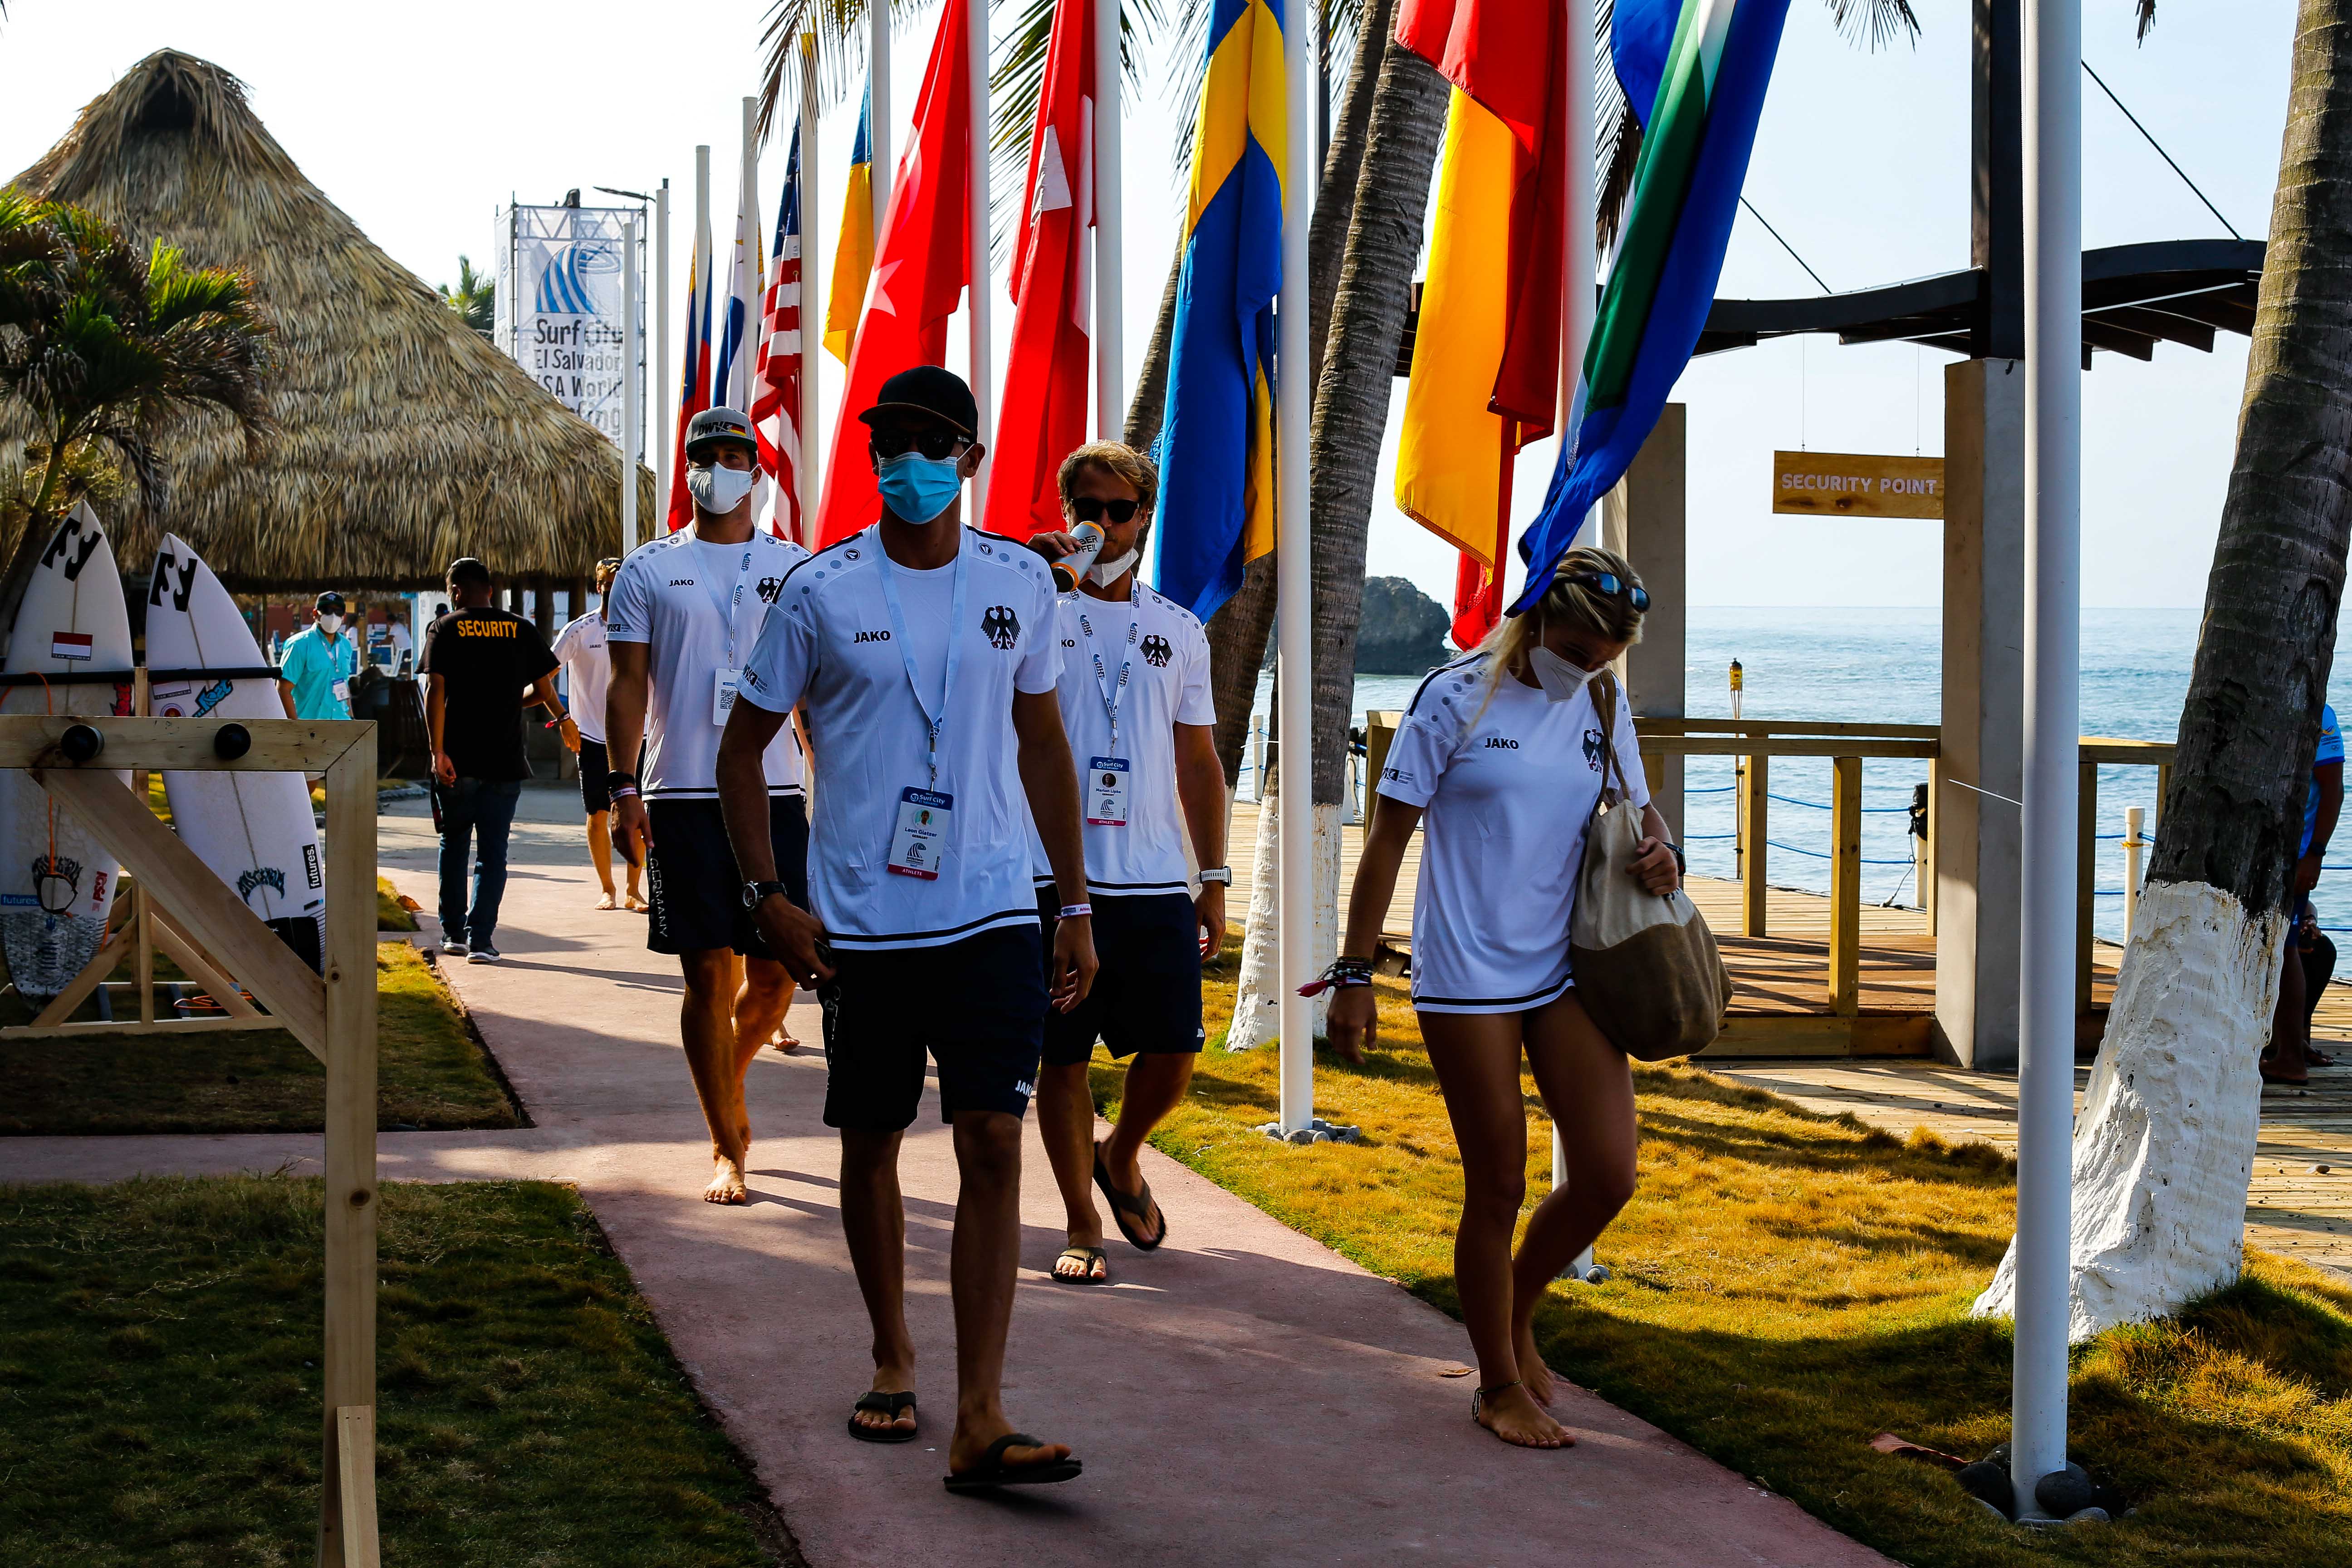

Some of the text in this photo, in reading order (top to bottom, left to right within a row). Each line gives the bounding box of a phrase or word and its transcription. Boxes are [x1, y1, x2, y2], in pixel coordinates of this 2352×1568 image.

[534, 318, 582, 346] Surf
[534, 348, 620, 371] El Salvador
[1781, 473, 1938, 495] SECURITY POINT
[457, 620, 518, 638] SECURITY
[853, 630, 891, 643] JAKO
[1061, 639, 1075, 647] KO
[1485, 738, 1519, 750] JAKO
[307, 845, 320, 887] futures.
[902, 868, 923, 876] ATHLETE
[3, 895, 39, 905] futures.
[650, 858, 668, 937] GERMANY
